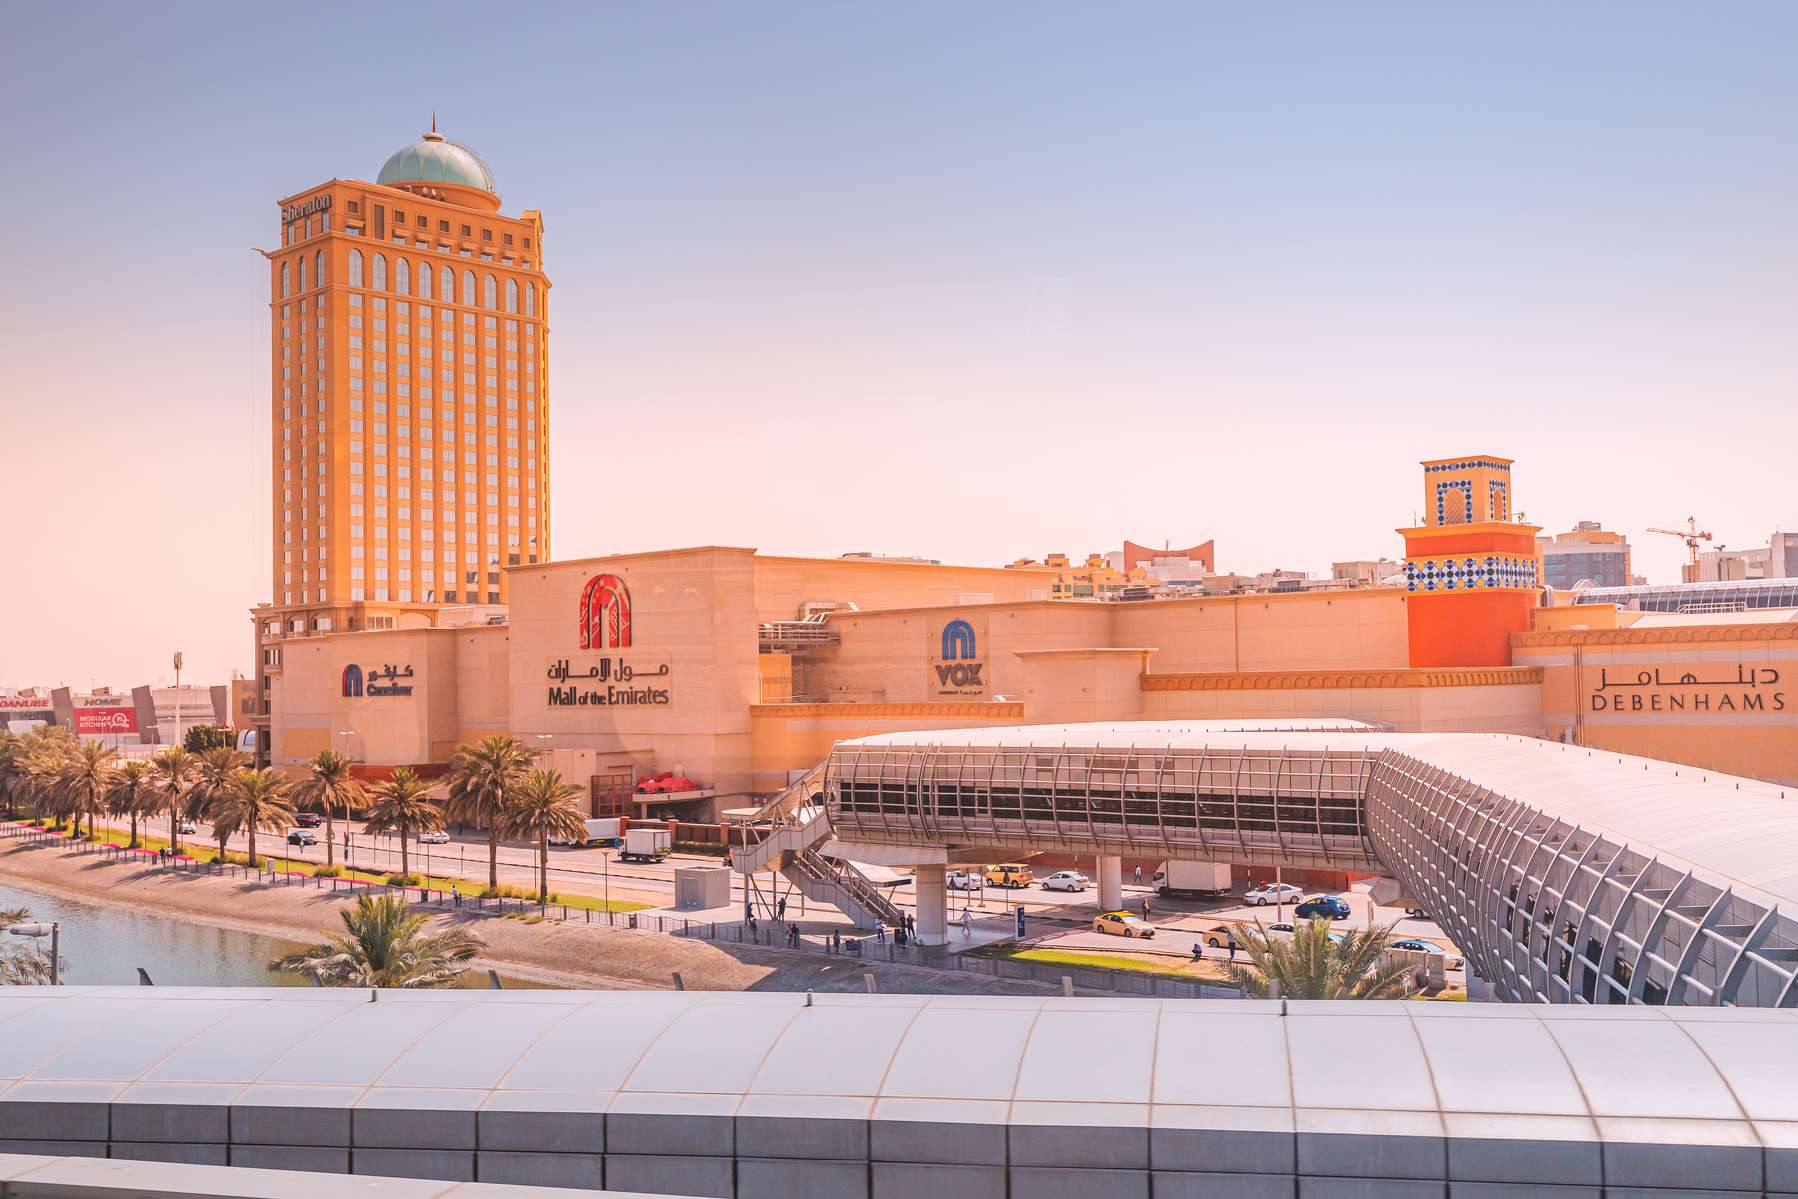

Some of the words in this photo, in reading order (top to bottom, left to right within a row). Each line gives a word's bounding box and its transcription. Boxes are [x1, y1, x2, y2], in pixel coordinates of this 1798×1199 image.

[282, 194, 332, 224] Sheraton
[614, 657, 669, 682] مول
[934, 662, 983, 687] VOX
[0, 699, 49, 708] DANUBE
[84, 698, 122, 706] HOME
[548, 687, 576, 706] Mall
[578, 691, 588, 705] of
[590, 691, 606, 705] the
[608, 685, 669, 705] Emirates
[1592, 692, 1785, 711] DEBENHAMS
